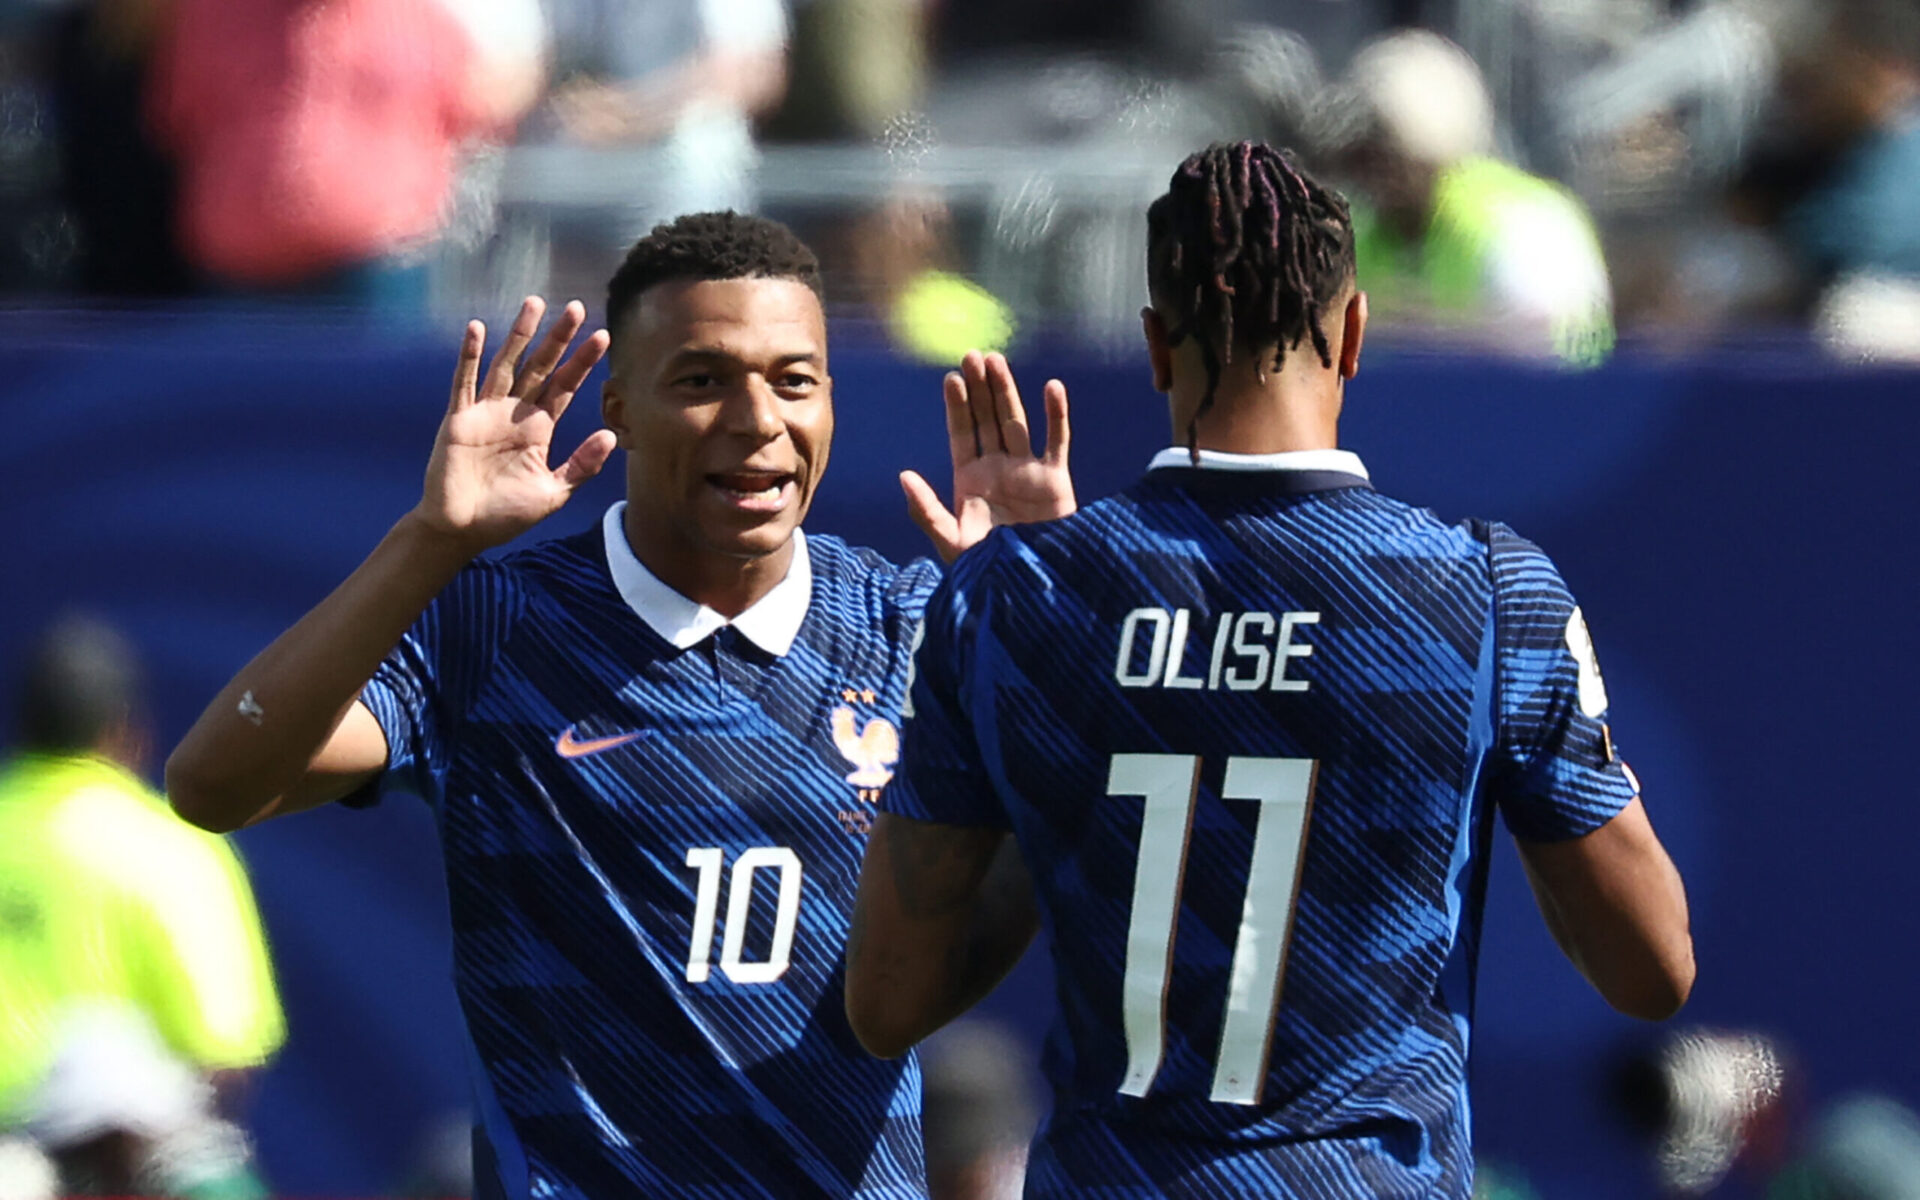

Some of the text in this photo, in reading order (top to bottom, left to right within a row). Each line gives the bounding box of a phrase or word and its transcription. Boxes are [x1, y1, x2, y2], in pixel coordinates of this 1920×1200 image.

[1115, 608, 1320, 691] OLISE
[686, 847, 802, 983] 10
[1107, 753, 1320, 1105] 11
